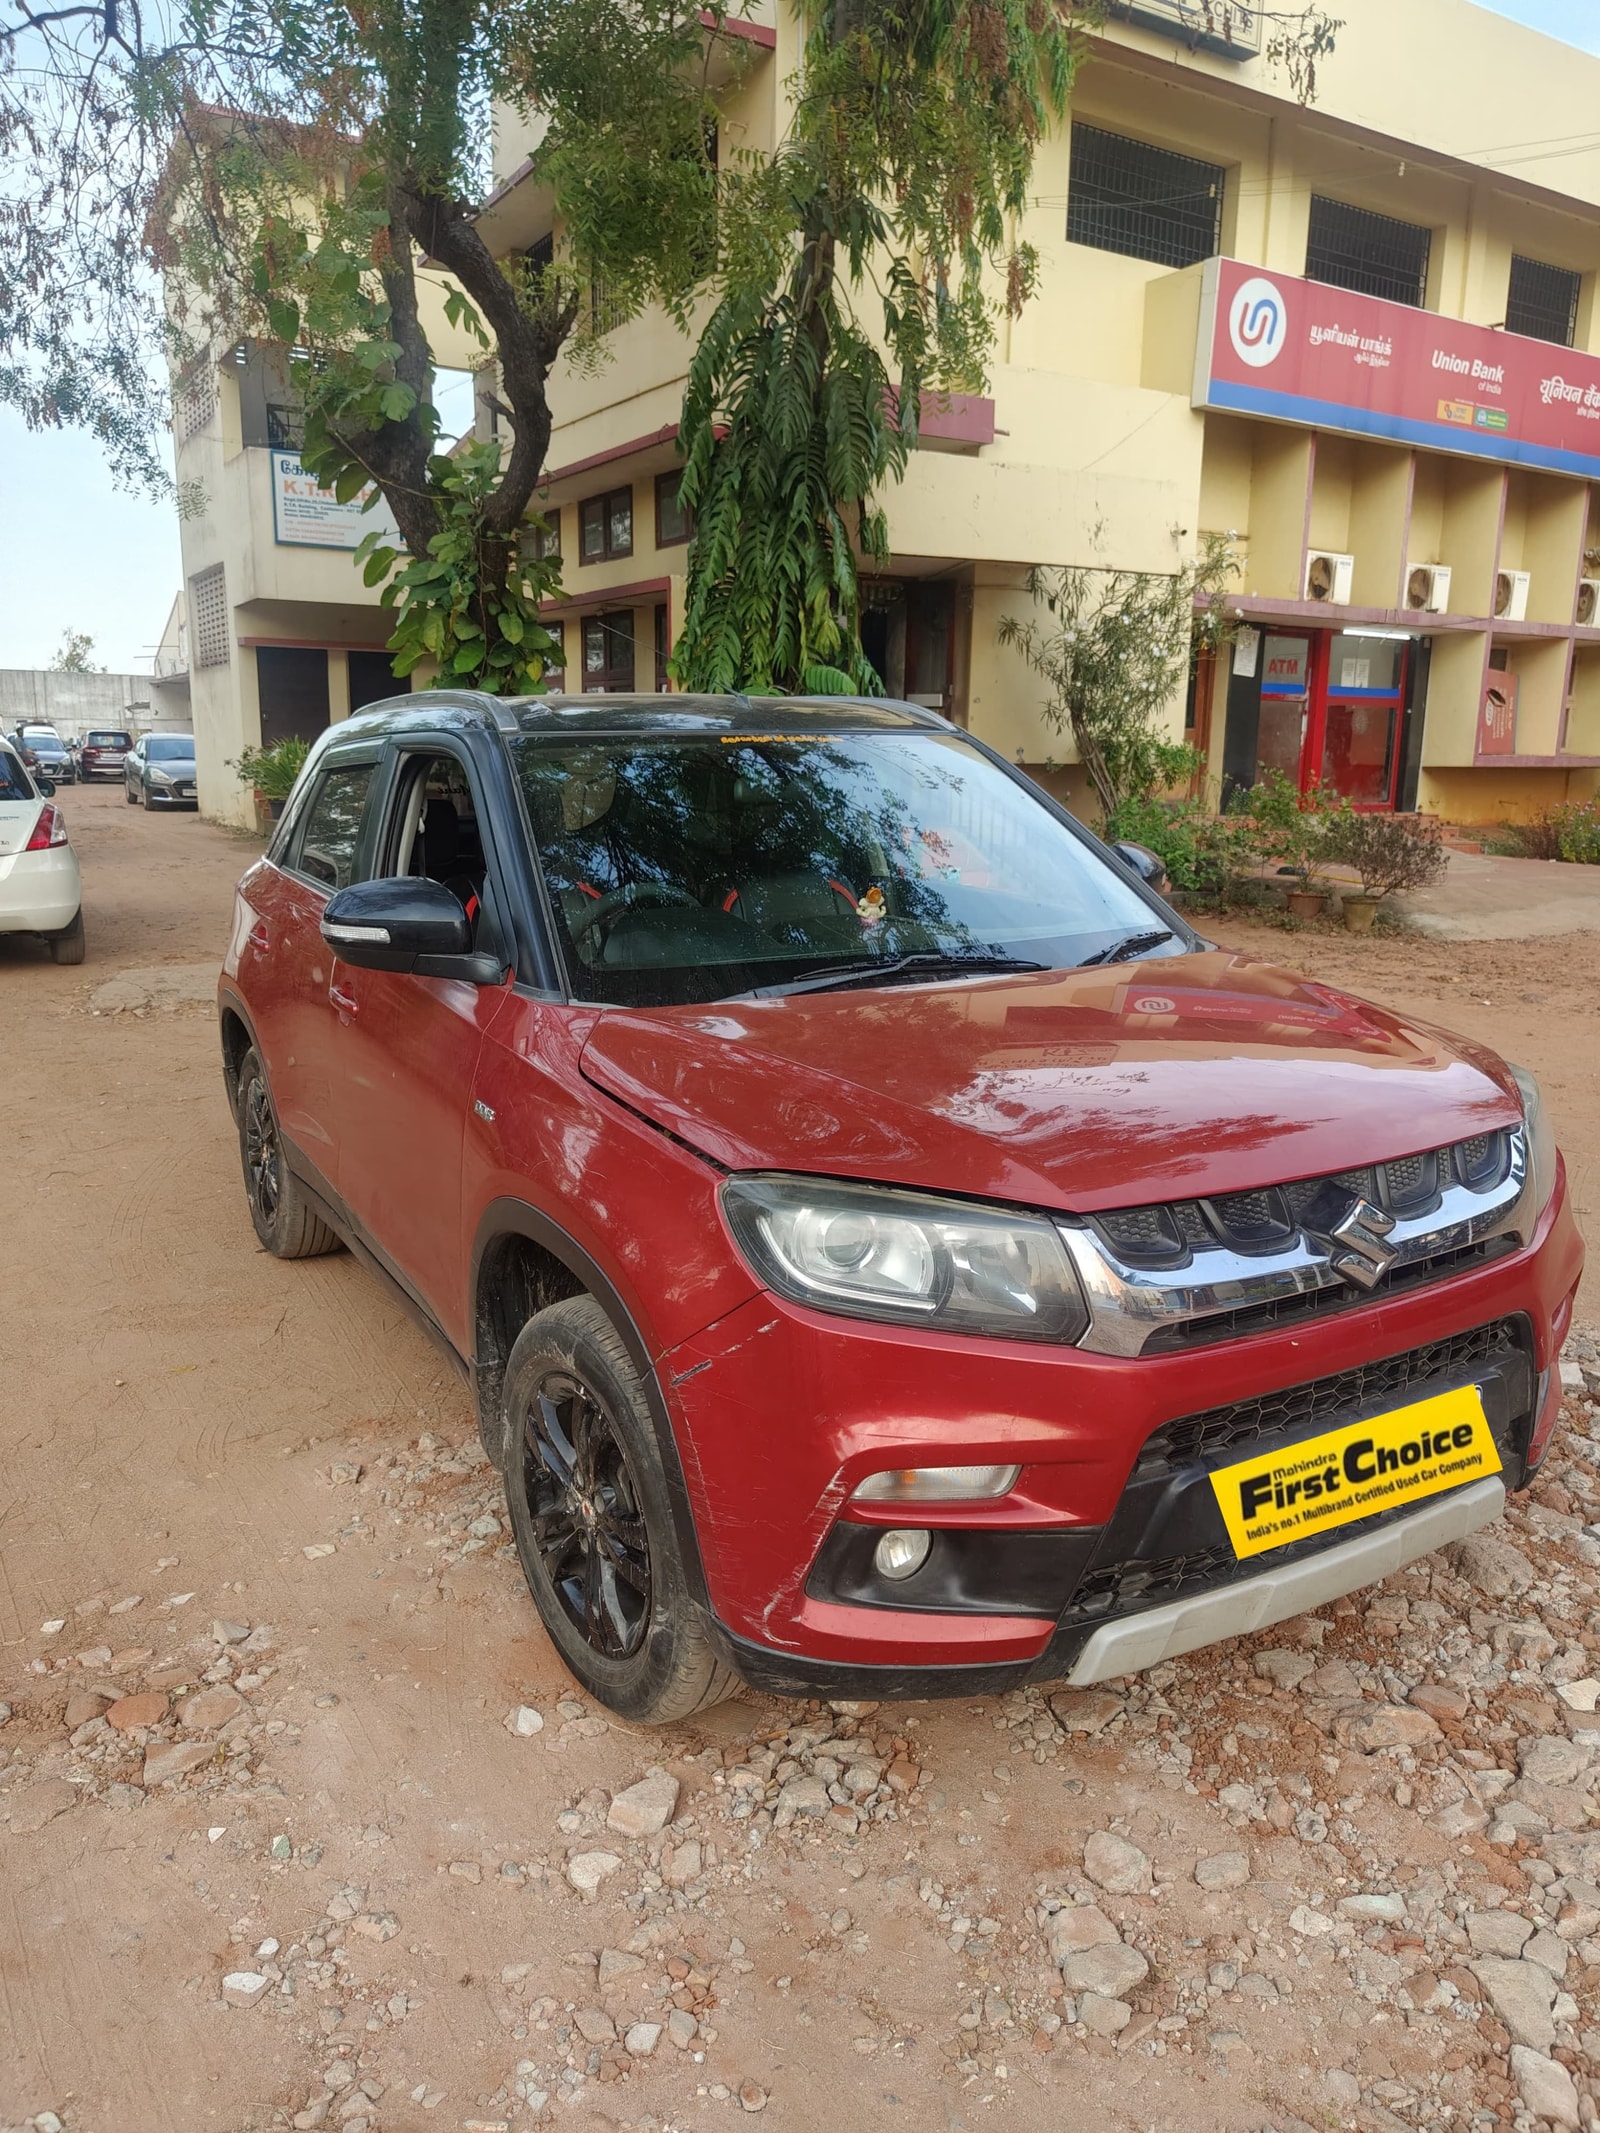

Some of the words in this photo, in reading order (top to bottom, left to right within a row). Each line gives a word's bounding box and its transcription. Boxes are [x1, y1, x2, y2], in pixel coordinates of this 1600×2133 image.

[1432, 349, 1470, 375] Union
[1471, 359, 1504, 383] Bank
[1478, 381, 1486, 391] of
[1486, 382, 1502, 395] India
[1540, 376, 1584, 404] यूनियन
[1268, 659, 1298, 675] ATM
[1239, 1465, 1340, 1521] First
[1343, 1423, 1473, 1483] Choice
[1273, 1453, 1337, 1480] Mahindra
[1246, 1522, 1279, 1540] India's
[1280, 1514, 1301, 1530] no.1
[1302, 1495, 1354, 1521] Multibrand
[1354, 1481, 1395, 1504] Certified
[1395, 1473, 1420, 1490] Used
[1421, 1467, 1438, 1481] Car
[1438, 1452, 1482, 1475] Company
